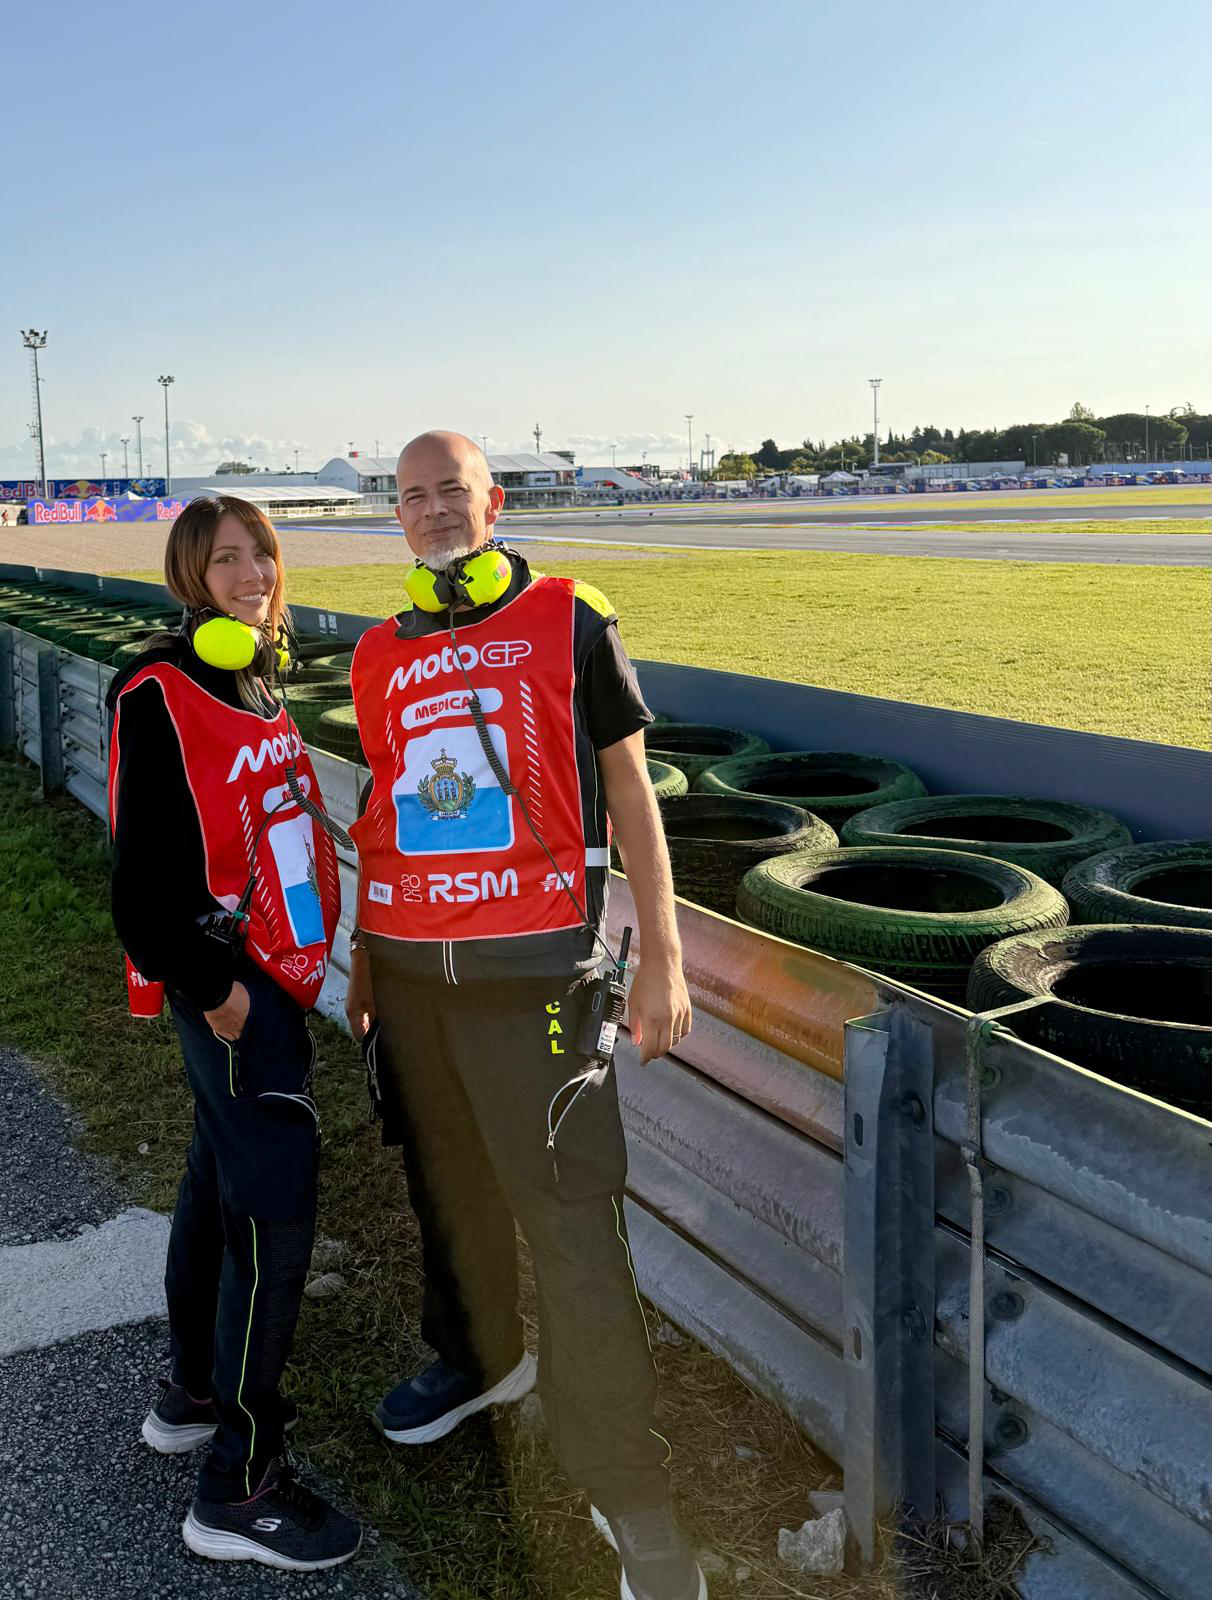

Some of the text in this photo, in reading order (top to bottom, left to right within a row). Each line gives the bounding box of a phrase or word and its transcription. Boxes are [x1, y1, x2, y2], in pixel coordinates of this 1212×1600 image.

[34, 501, 82, 523] Red Bull
[156, 501, 175, 520] Red
[415, 695, 476, 720] MEDICA
[428, 868, 518, 903] RSM
